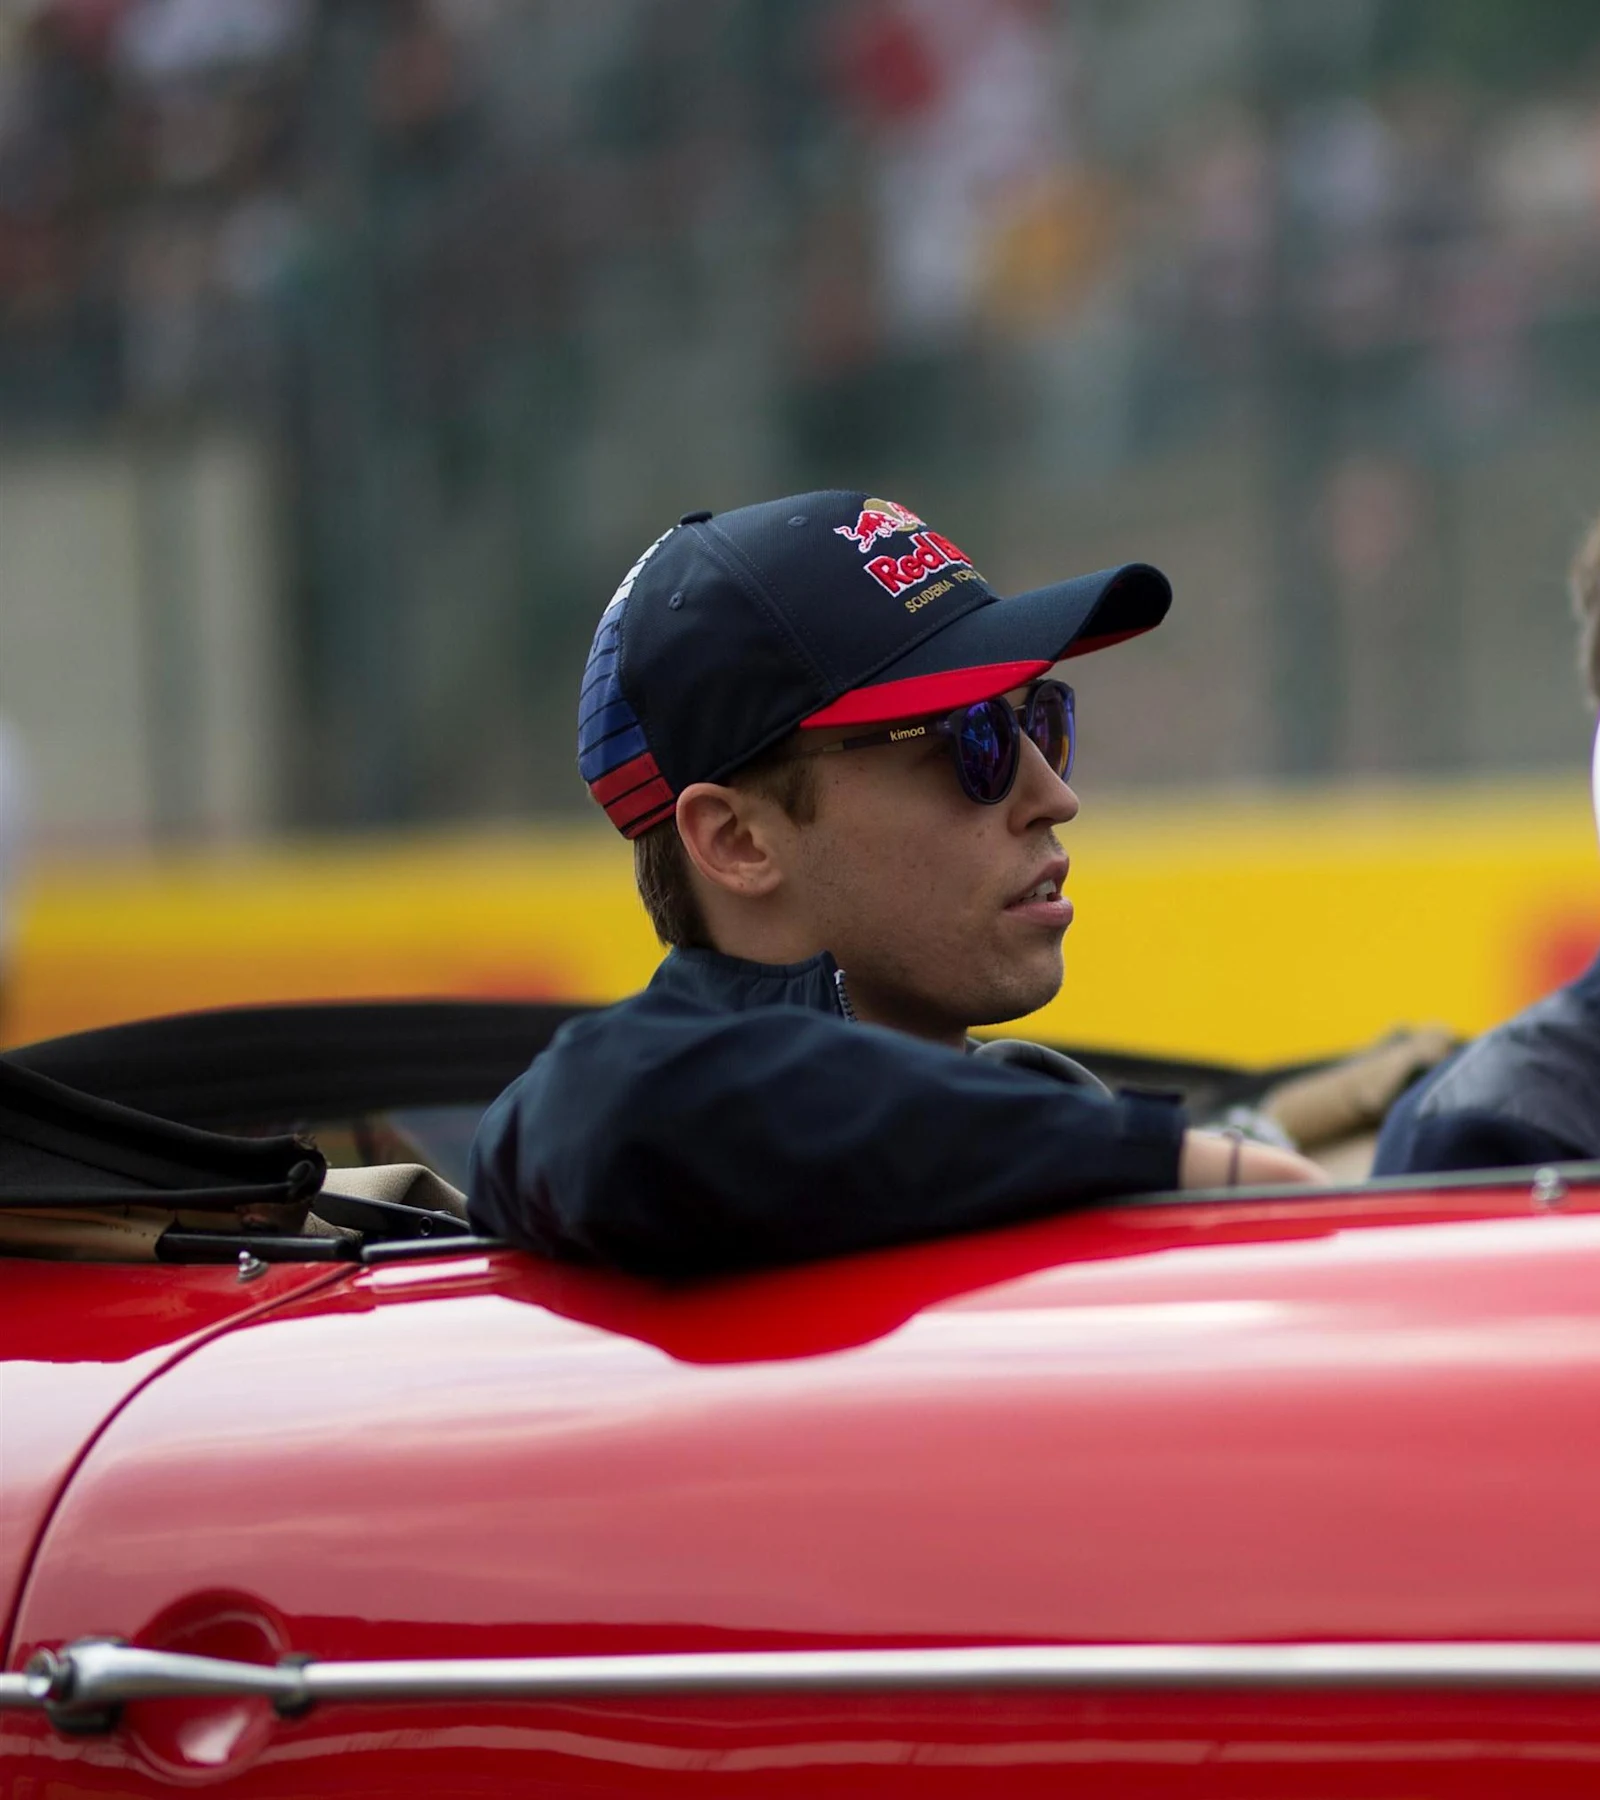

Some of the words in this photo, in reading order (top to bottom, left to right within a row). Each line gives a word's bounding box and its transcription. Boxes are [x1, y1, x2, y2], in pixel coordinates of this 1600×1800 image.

[863, 533, 949, 597] Red
[904, 579, 955, 613] SCUDERIA
[890, 726, 926, 741] kimoa
